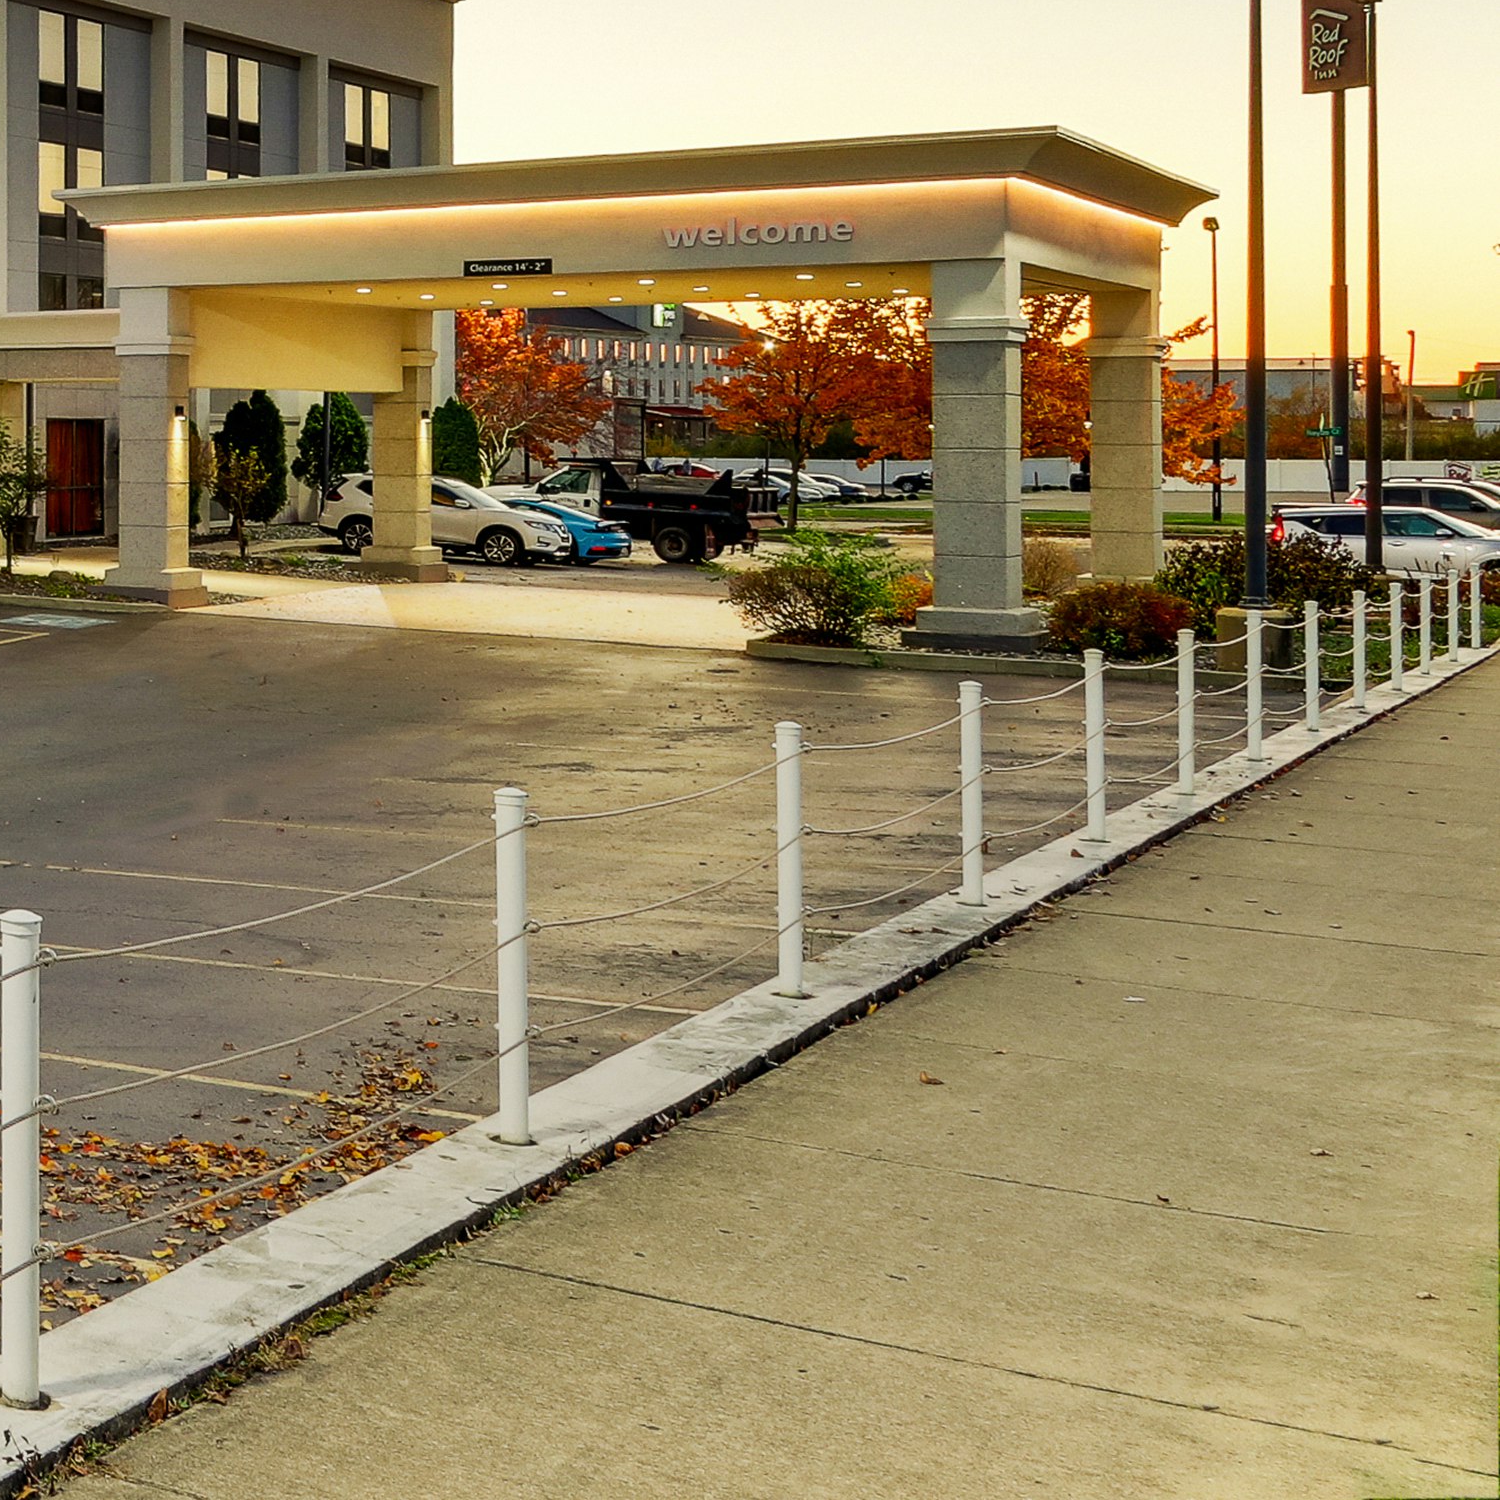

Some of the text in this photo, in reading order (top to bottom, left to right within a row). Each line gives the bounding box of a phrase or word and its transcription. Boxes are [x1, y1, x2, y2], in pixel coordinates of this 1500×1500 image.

[1312, 23, 1340, 45] Red
[1309, 38, 1348, 71] Roof
[1314, 69, 1337, 80] Inn
[662, 217, 855, 248] welcome
[470, 263, 513, 273] Clearance
